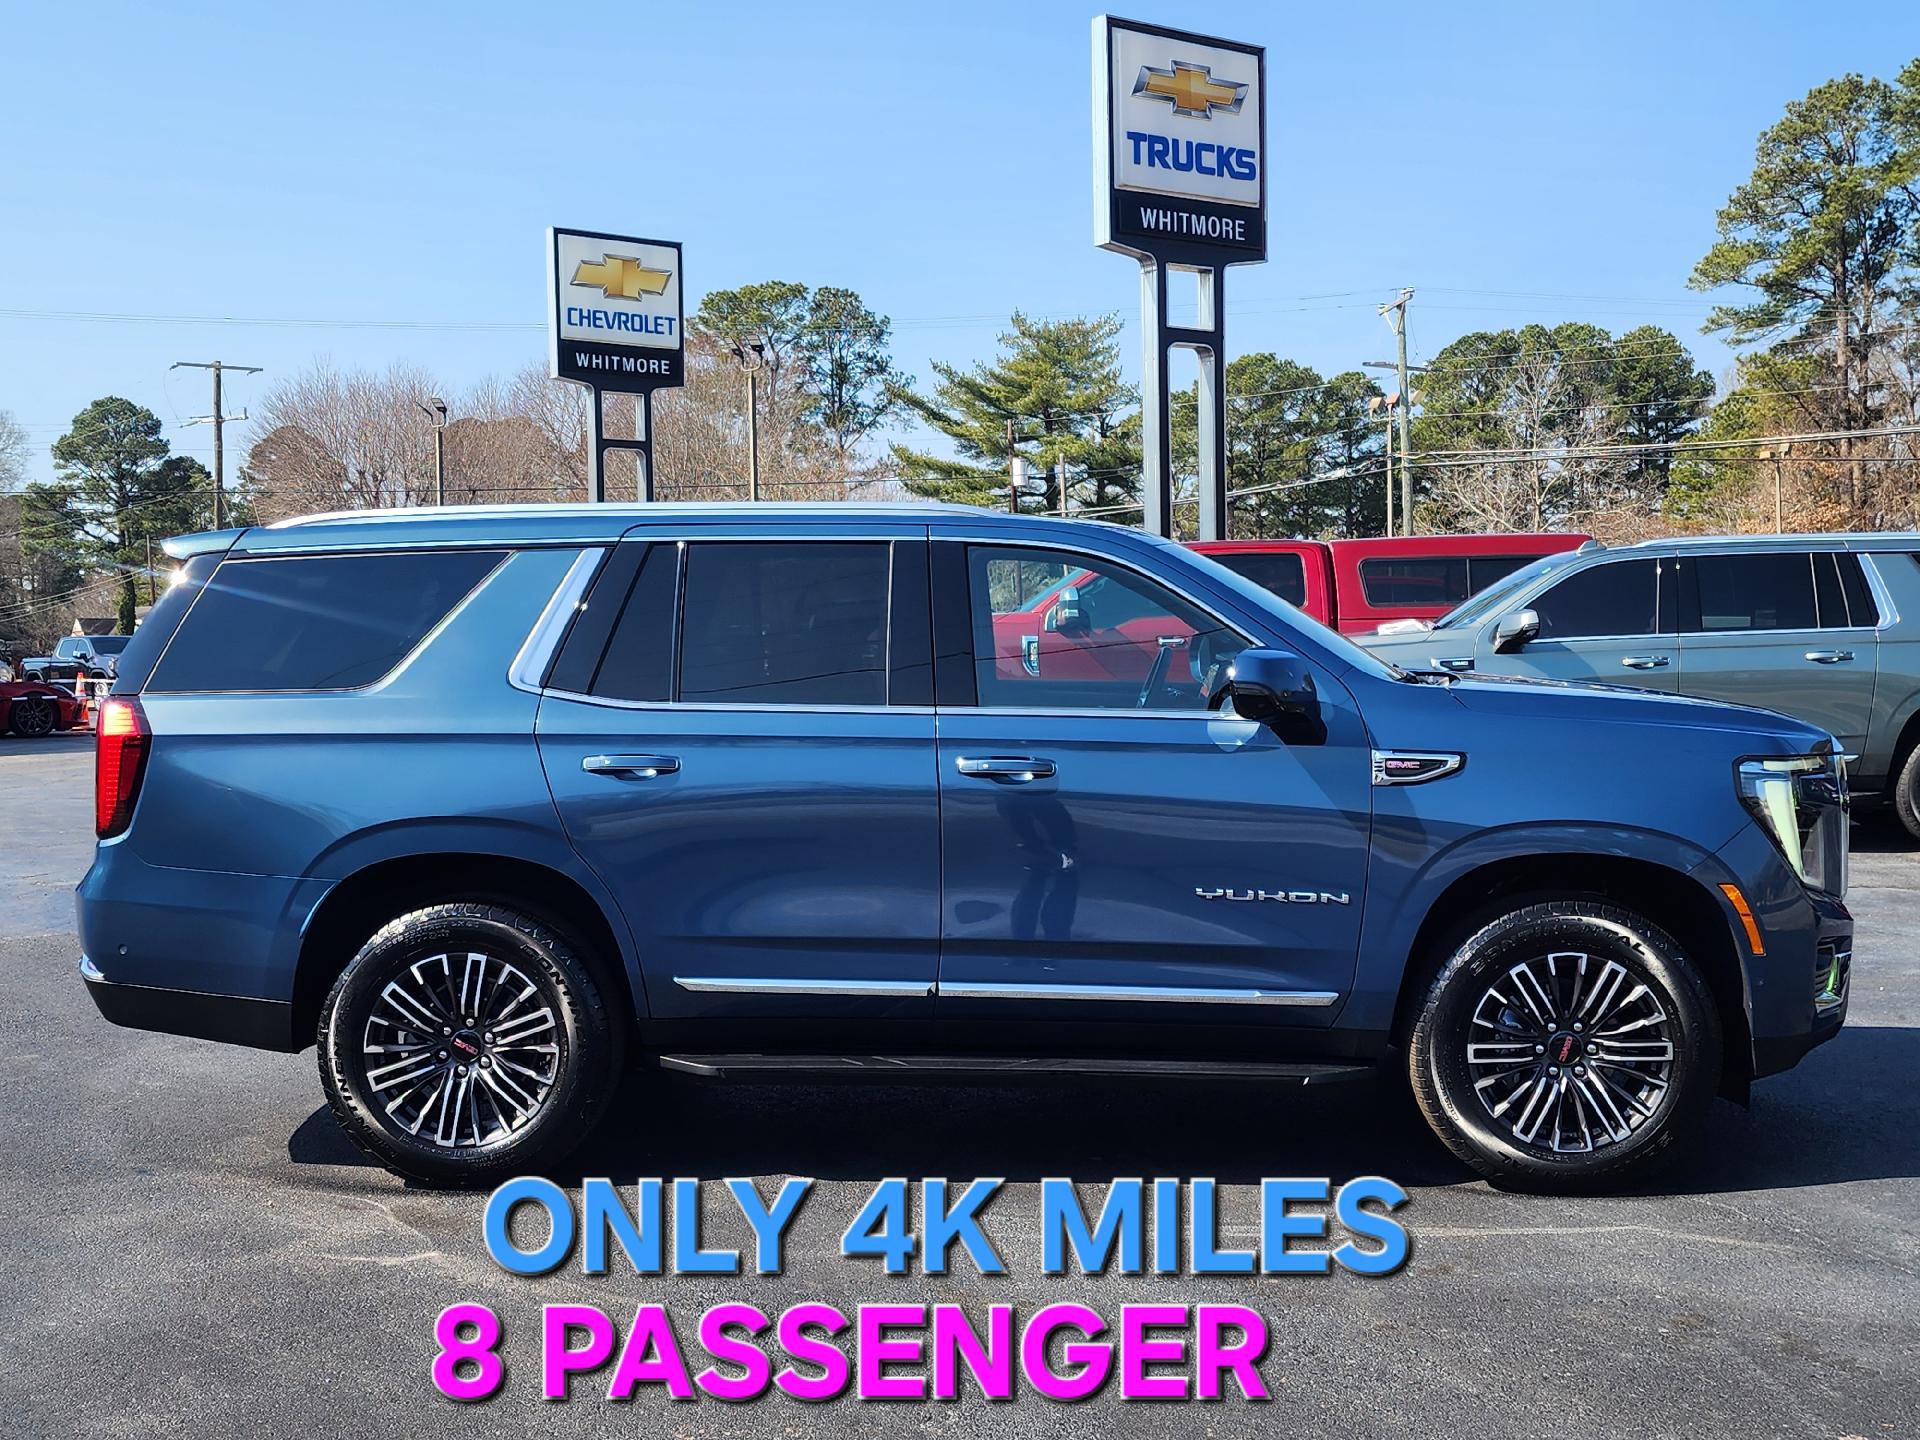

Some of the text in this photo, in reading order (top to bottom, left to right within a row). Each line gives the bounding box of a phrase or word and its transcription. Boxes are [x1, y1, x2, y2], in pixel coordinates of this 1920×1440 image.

[1126, 131, 1257, 181] TRUCKS
[1140, 207, 1246, 241] WHITMORE
[567, 307, 677, 335] CHEVROLET
[575, 352, 671, 375] WHITMORE
[1385, 760, 1420, 769] GMC
[1195, 887, 1350, 905] YUKON
